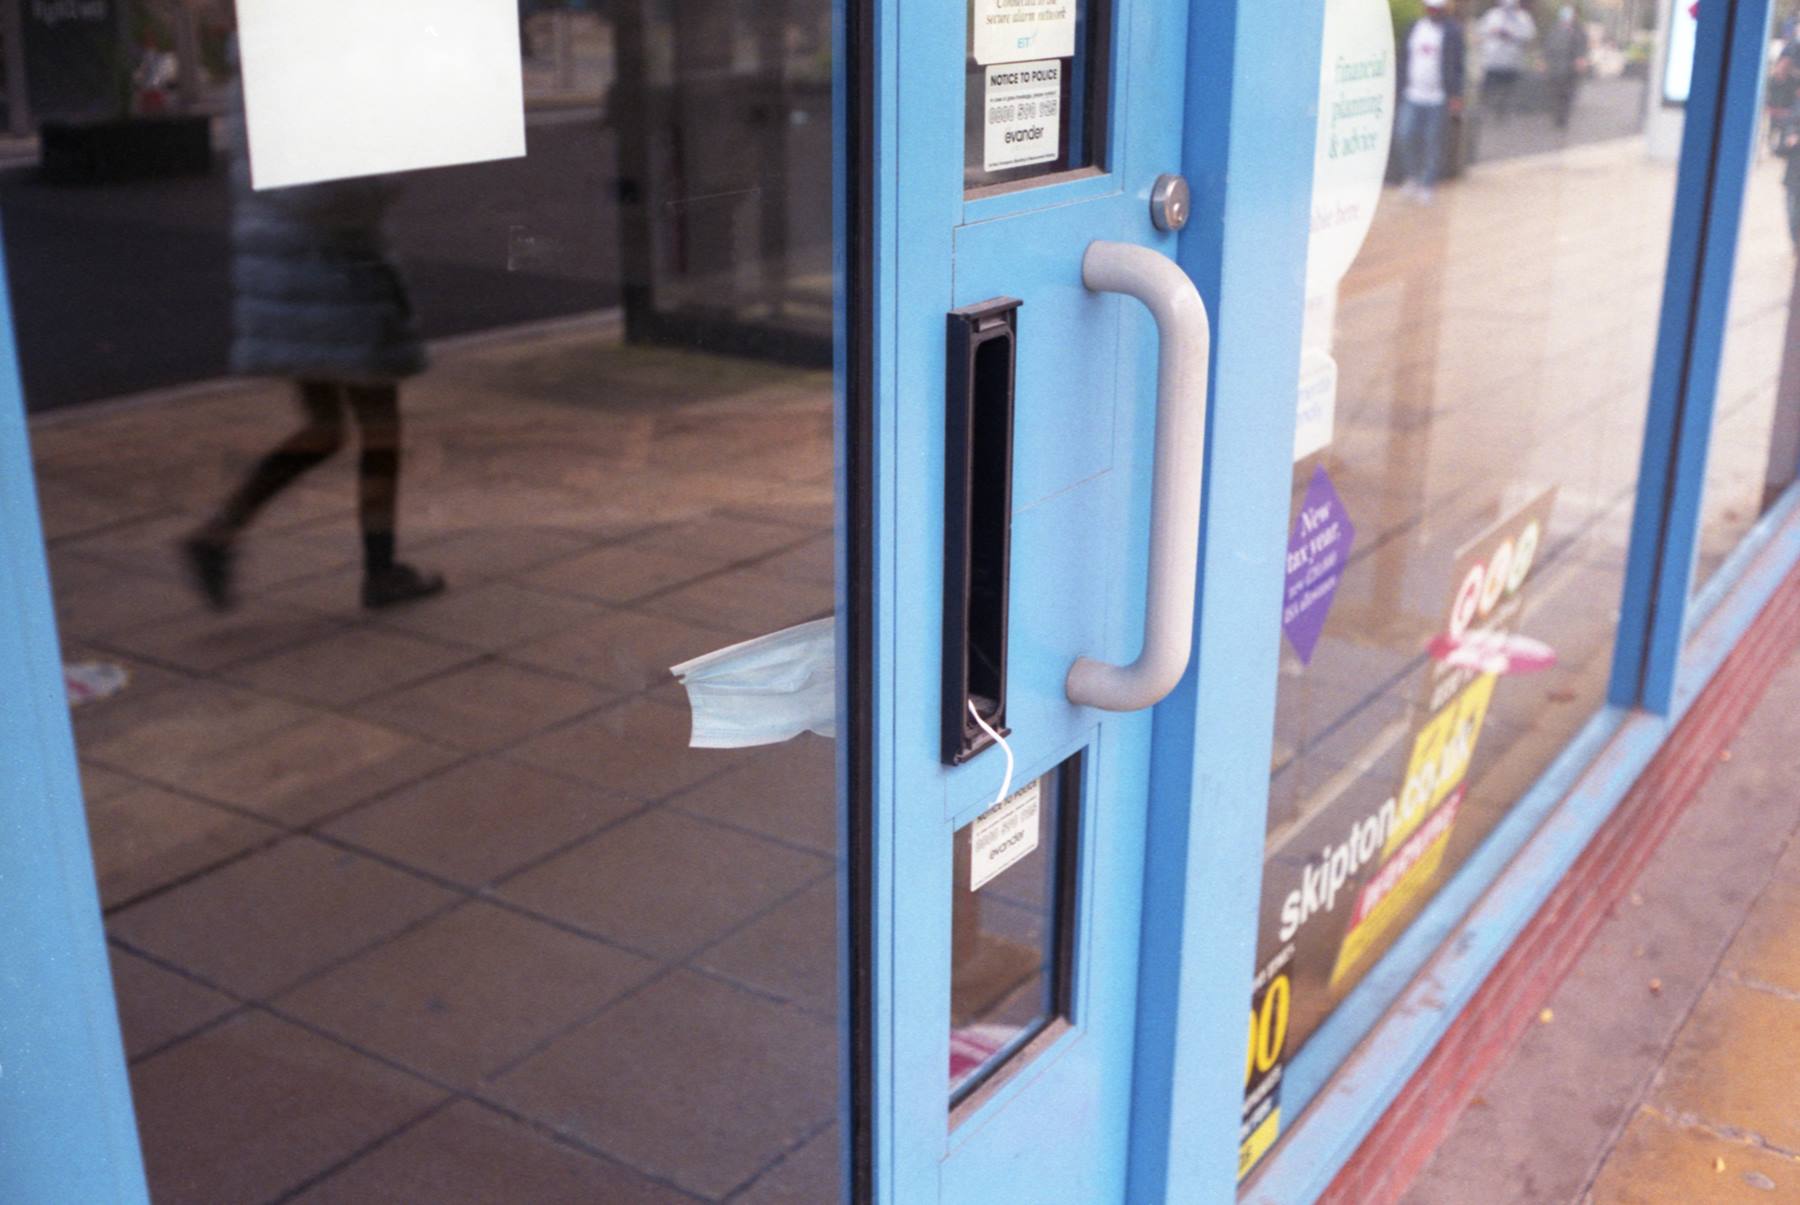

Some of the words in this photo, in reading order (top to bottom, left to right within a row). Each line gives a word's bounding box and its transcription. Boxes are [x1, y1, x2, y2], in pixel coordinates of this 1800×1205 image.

[990, 72, 1019, 87] NOTICE
[1020, 71, 1031, 84] TO
[1032, 68, 1058, 83] POLICE
[1005, 126, 1044, 144] evander
